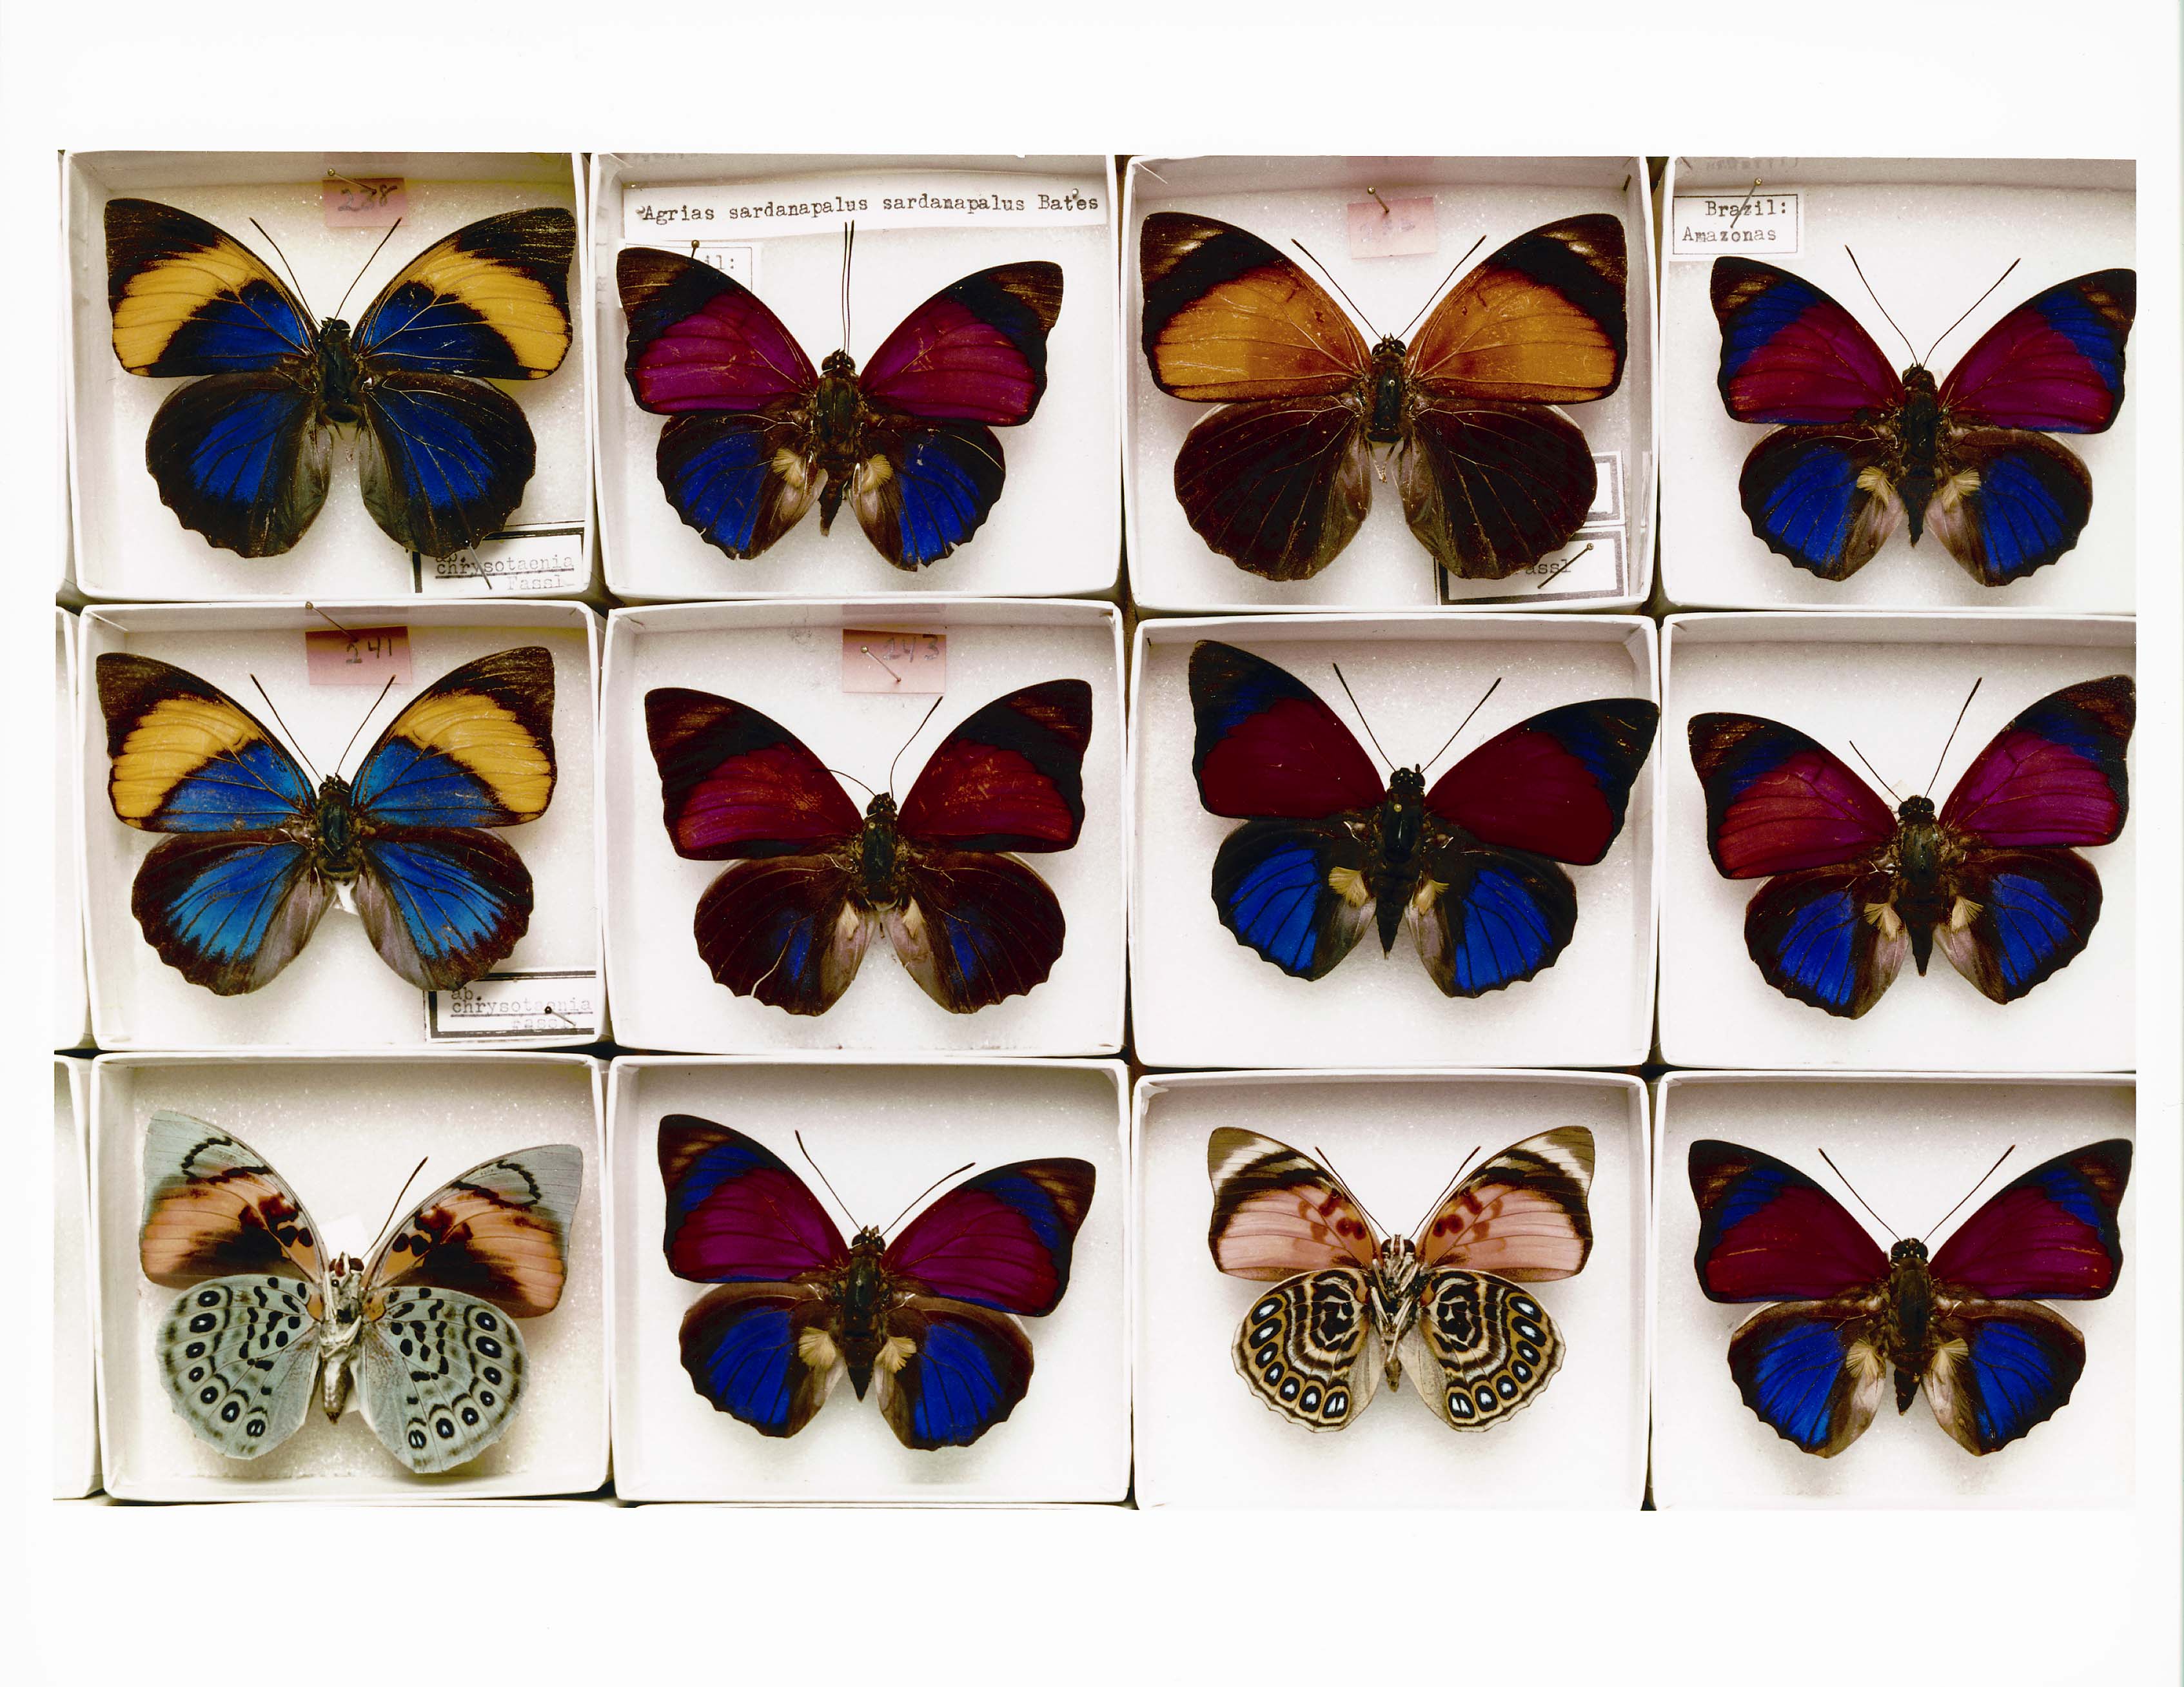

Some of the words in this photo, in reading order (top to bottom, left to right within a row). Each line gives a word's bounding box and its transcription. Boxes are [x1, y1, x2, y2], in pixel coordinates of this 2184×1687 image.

[642, 204, 715, 226] Agrias
[729, 196, 869, 220] sardanapalus
[883, 193, 1025, 214] sardanapalus
[1038, 194, 1099, 211] Bates
[1705, 199, 1786, 217] Brazil:
[1682, 226, 1776, 243] Amazonas
[437, 554, 574, 576] chrysotaenia
[346, 636, 392, 664] 241
[882, 634, 940, 663] 243
